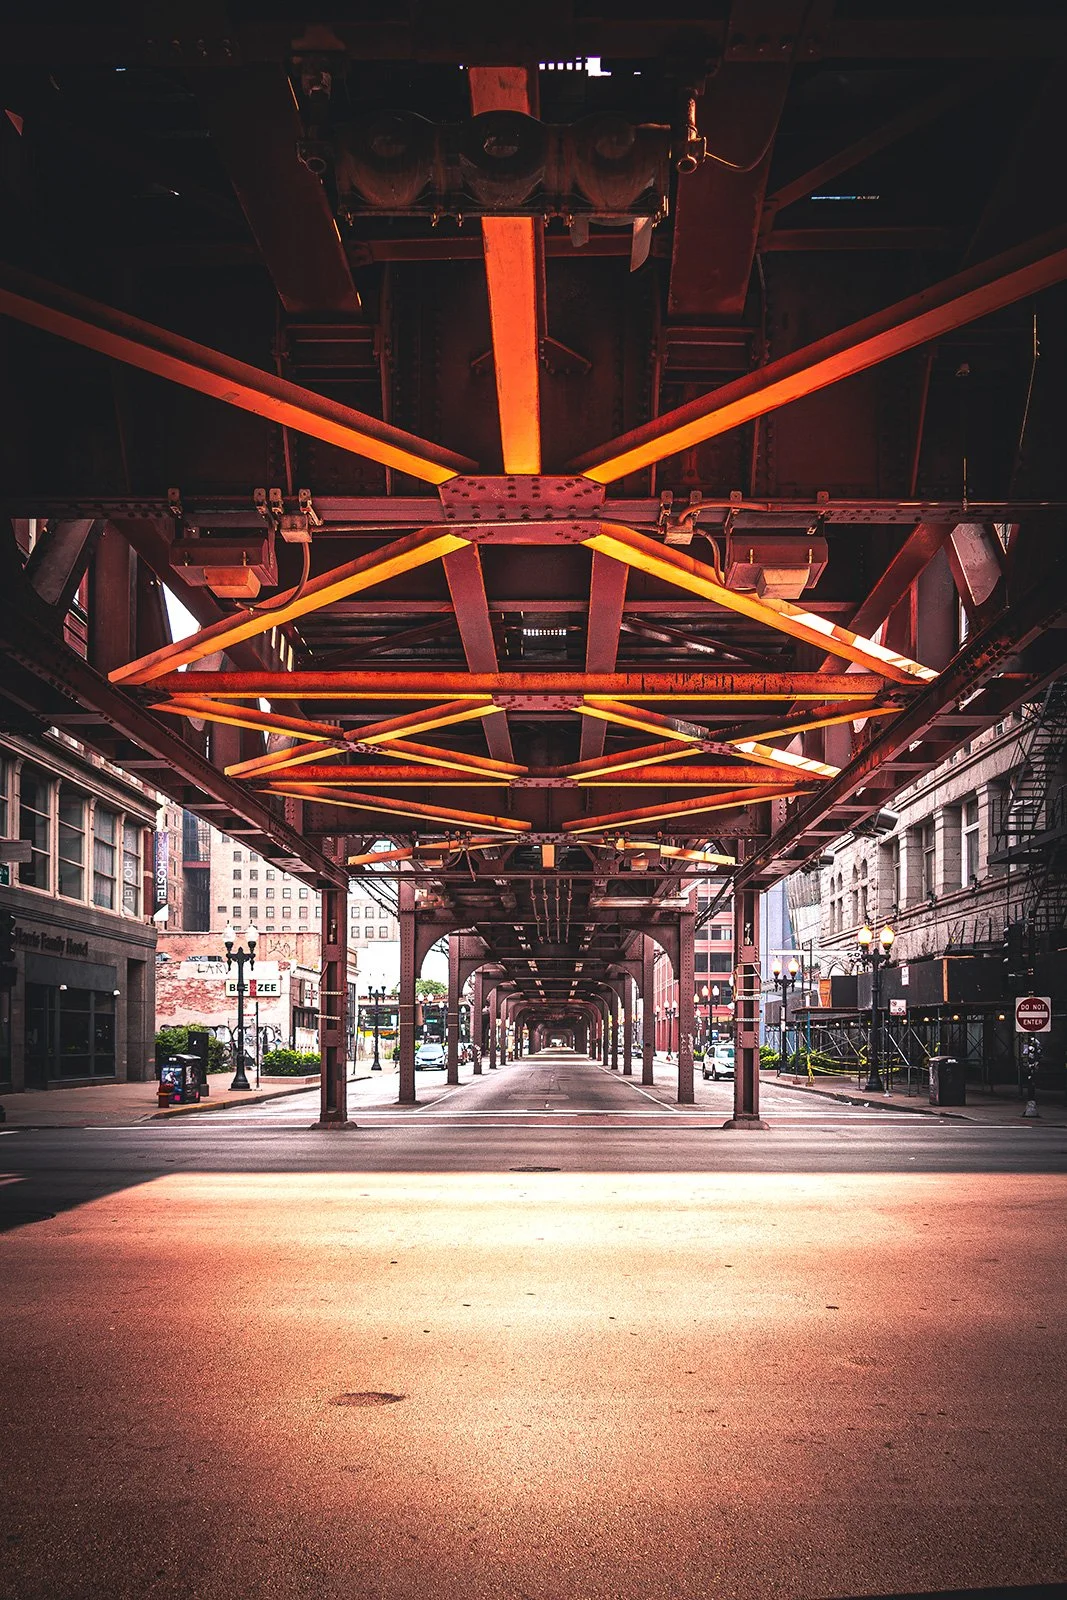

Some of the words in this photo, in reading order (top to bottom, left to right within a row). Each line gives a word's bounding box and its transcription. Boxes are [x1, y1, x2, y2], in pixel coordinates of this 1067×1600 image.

[157, 861, 167, 903] HOSTEL
[41, 932, 65, 957] Family
[66, 938, 89, 957] Hostel
[229, 983, 249, 992] BE
[257, 983, 277, 992] ZEE
